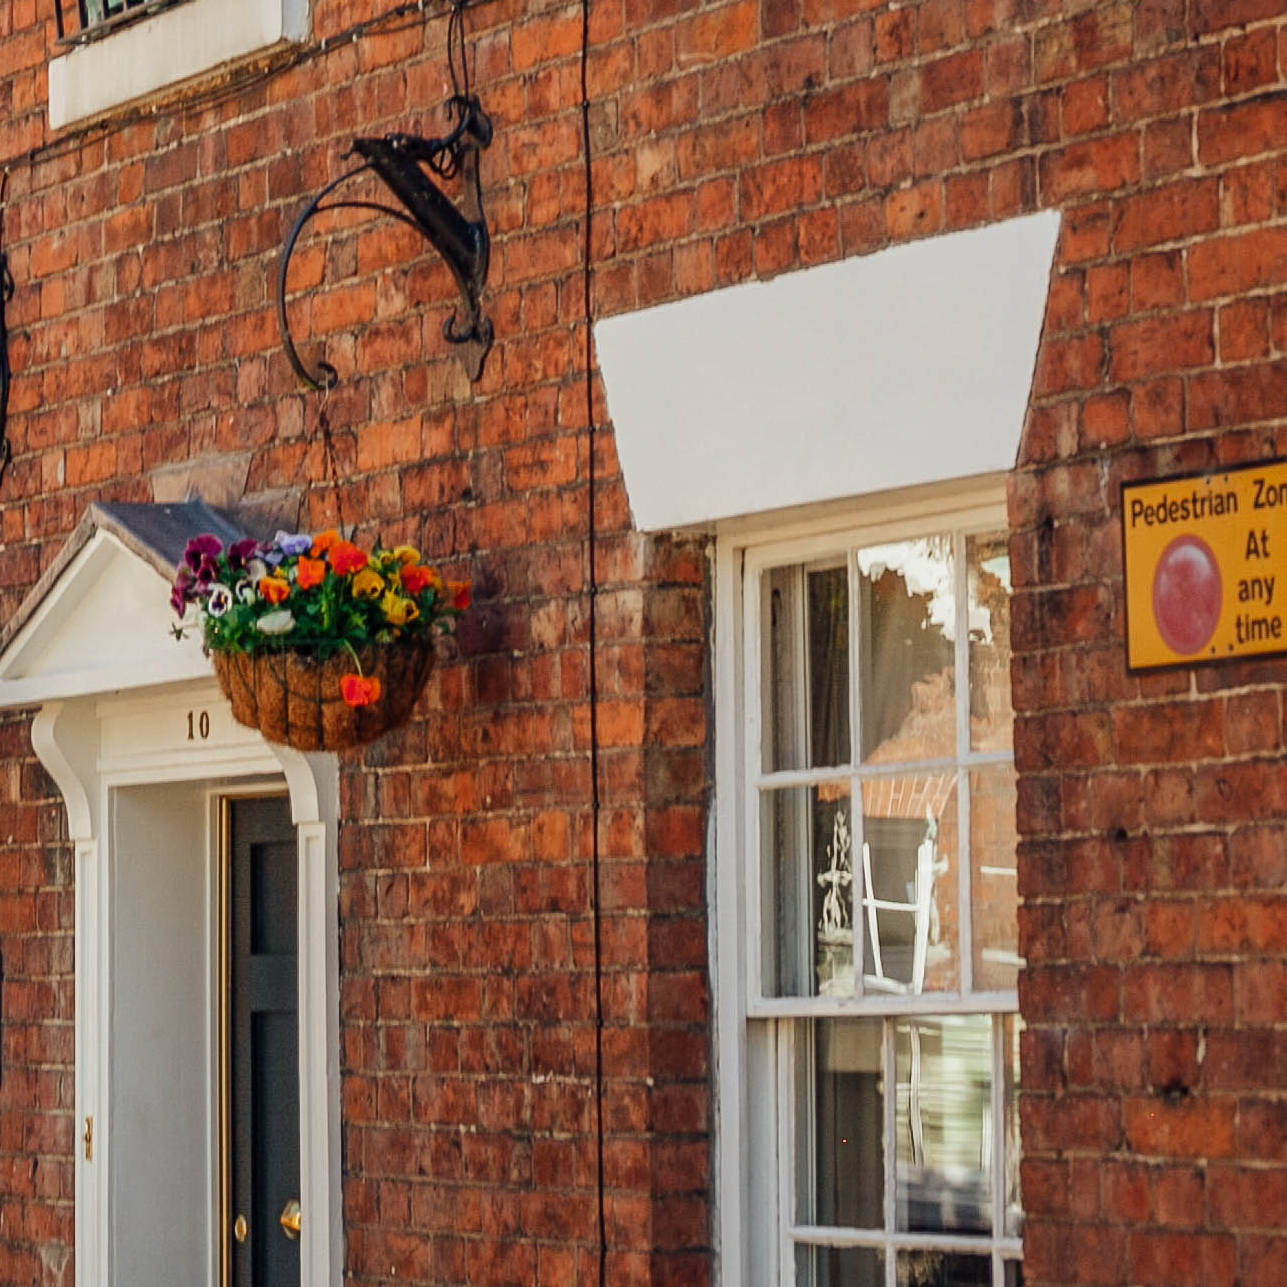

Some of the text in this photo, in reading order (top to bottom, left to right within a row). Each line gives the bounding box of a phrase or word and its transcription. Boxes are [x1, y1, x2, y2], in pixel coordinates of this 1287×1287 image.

[1131, 489, 1239, 528] Pedestrian
[1245, 529, 1270, 560] At
[1238, 576, 1275, 606] any
[1236, 614, 1282, 644] time
[187, 710, 210, 740] 10
